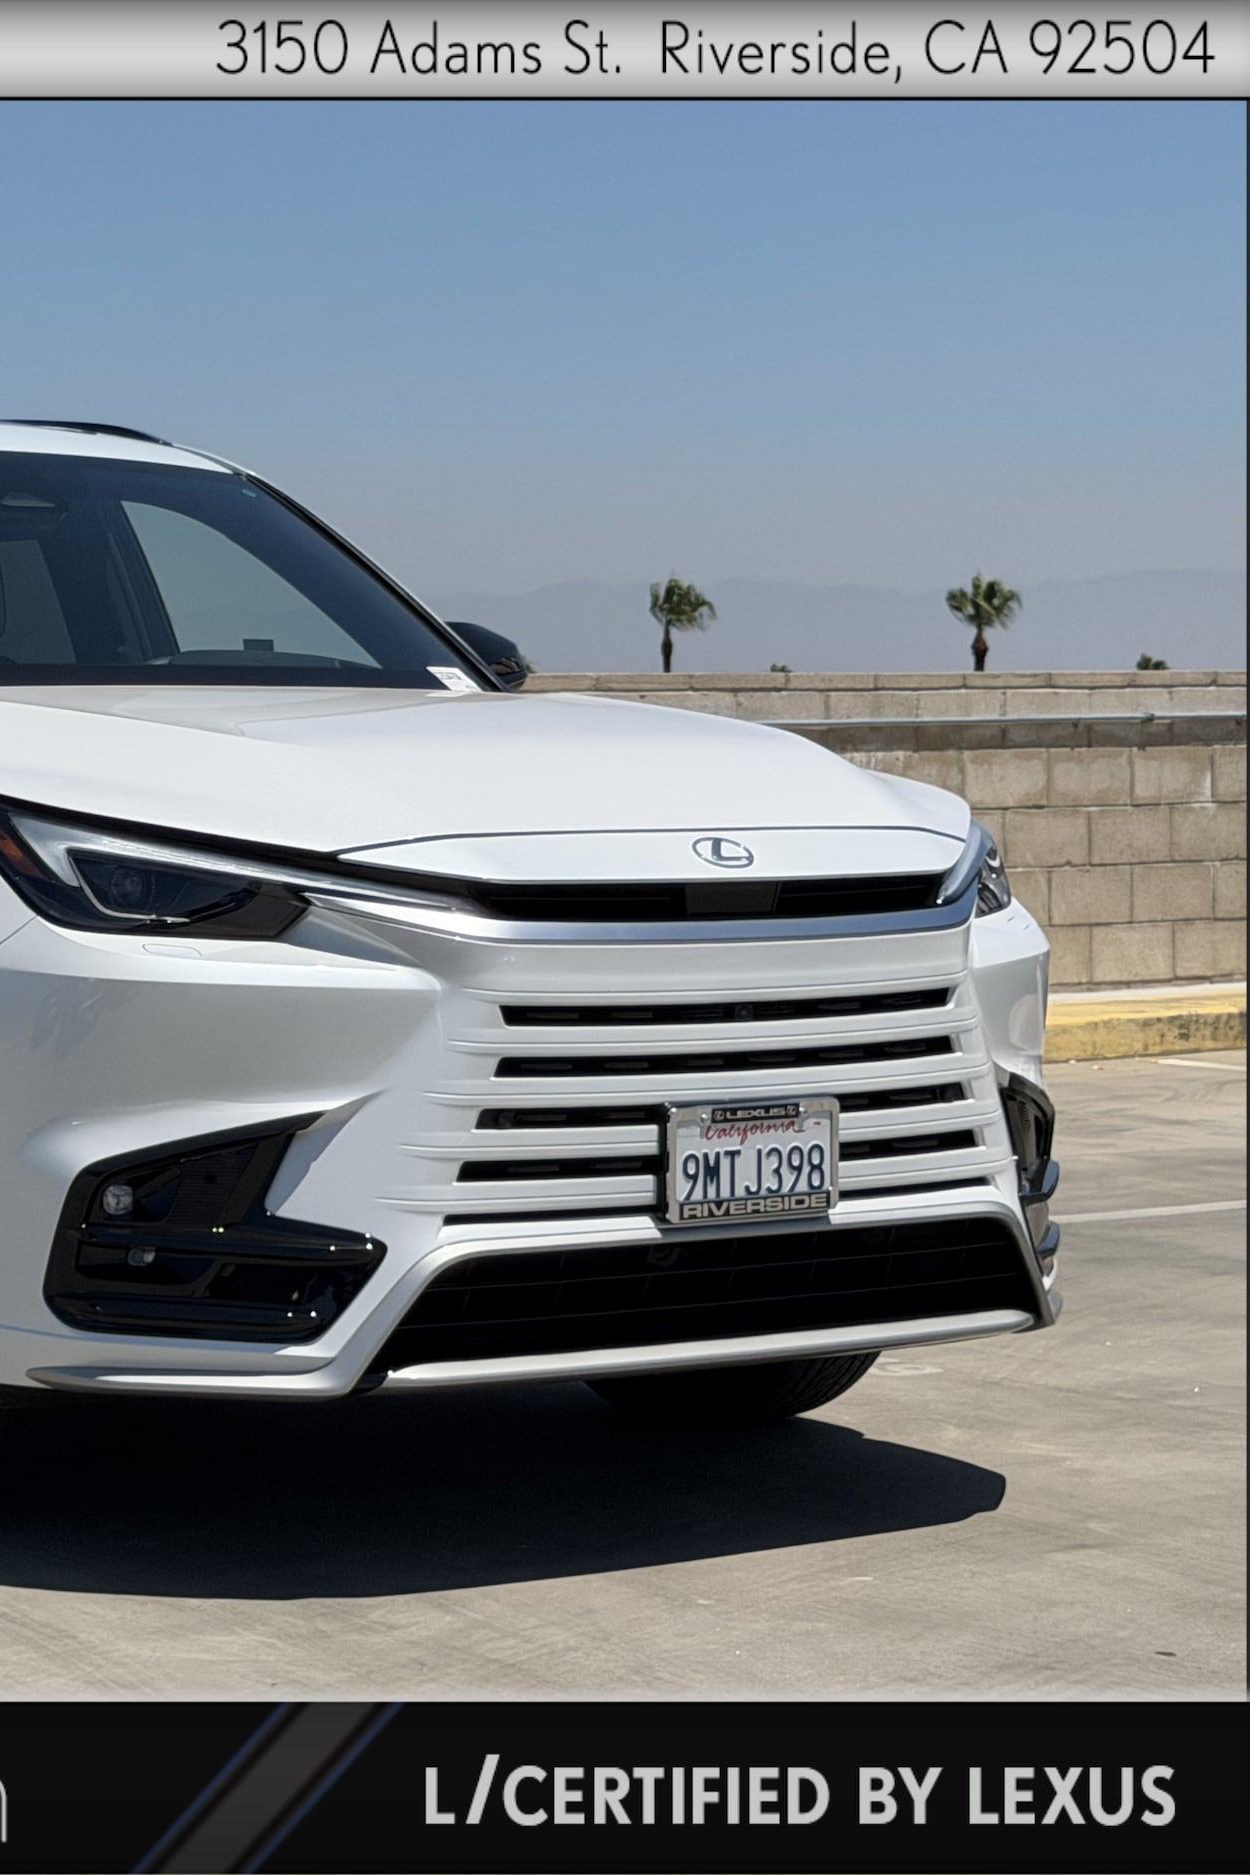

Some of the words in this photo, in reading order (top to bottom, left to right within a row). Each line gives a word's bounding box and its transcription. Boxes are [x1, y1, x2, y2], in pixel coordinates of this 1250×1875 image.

[725, 1107, 787, 1120] LEXUS
[705, 1119, 806, 1146] California
[682, 1143, 826, 1202] 9MTJ398
[682, 1195, 828, 1219] RIVERSIDE
